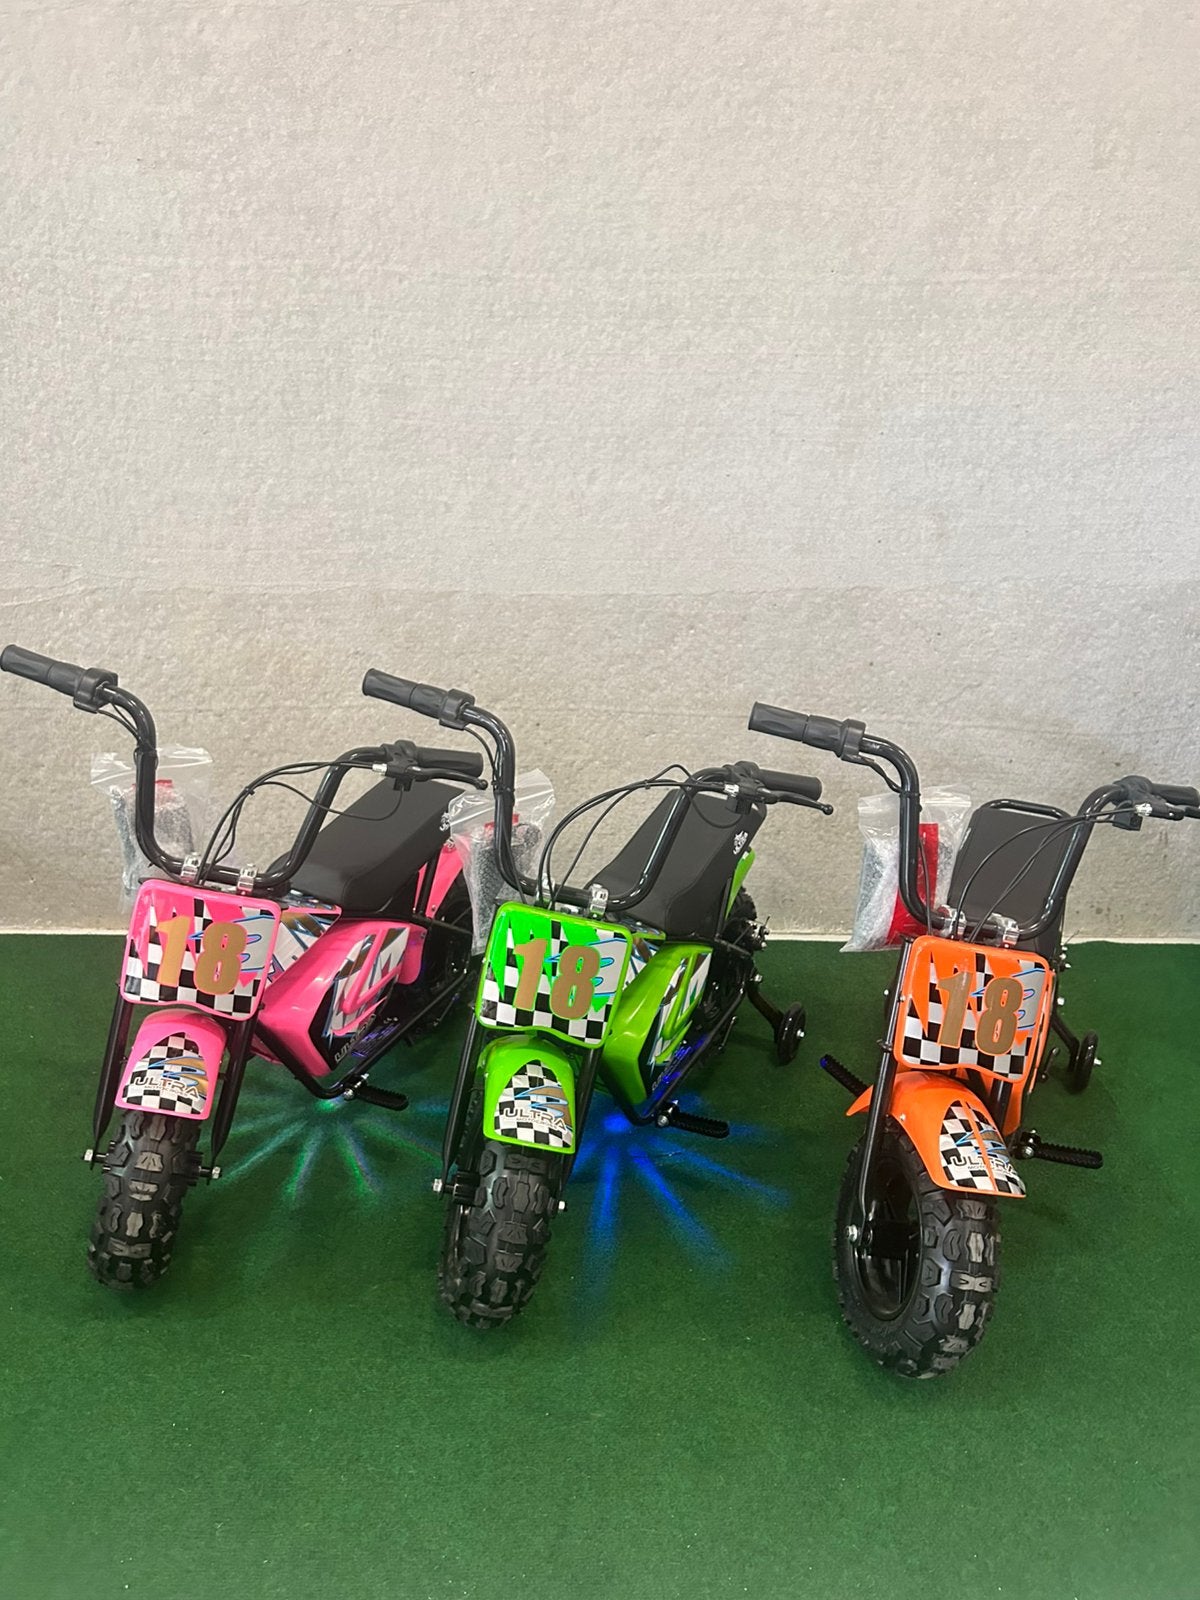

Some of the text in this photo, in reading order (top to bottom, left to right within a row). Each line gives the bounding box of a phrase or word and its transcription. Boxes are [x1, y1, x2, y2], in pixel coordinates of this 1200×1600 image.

[155, 914, 248, 995] 18
[513, 938, 600, 1019] 18
[936, 970, 1024, 1056] 18
[134, 1076, 199, 1099] ULTRA
[504, 1108, 567, 1131] ULTRA
